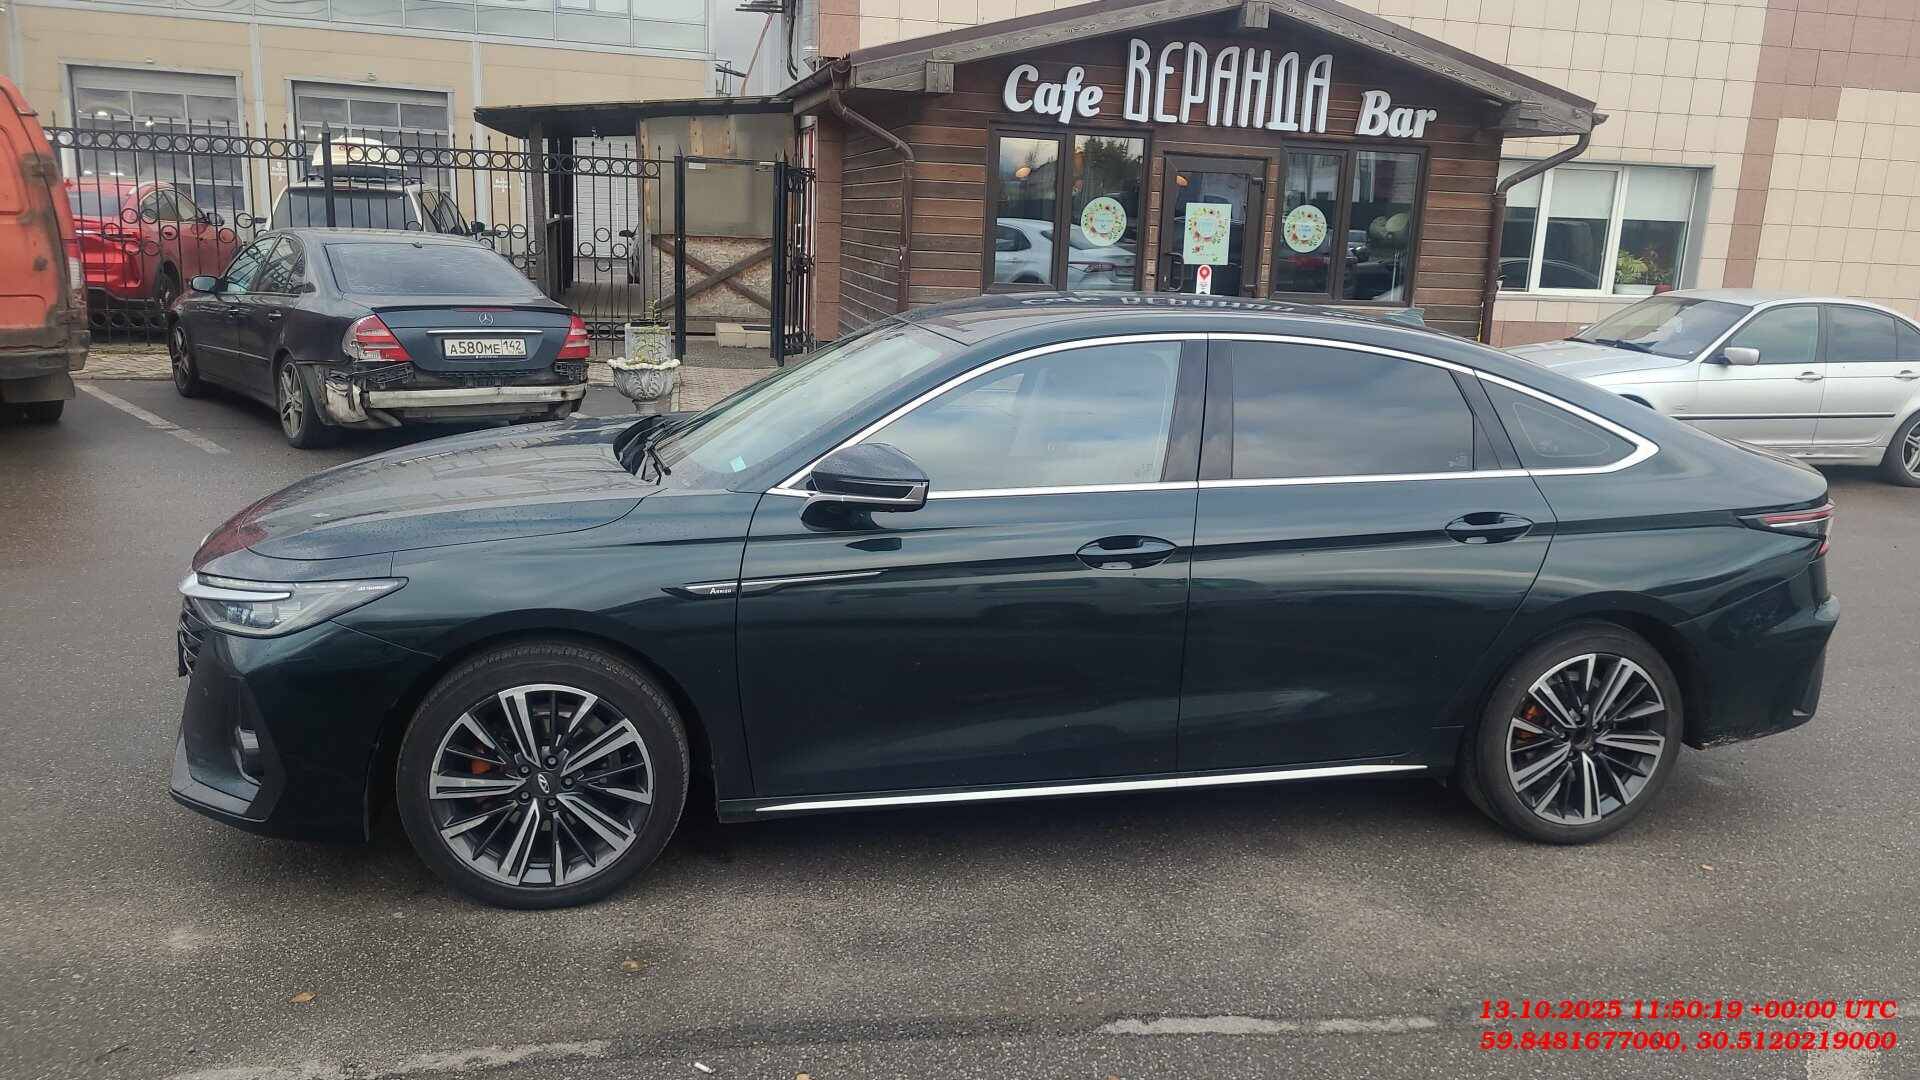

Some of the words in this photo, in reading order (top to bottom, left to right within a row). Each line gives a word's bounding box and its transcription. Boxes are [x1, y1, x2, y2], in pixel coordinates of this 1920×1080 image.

[1003, 63, 1104, 125] Cafe
[1122, 38, 1334, 134] ВЕРАНДА
[1355, 90, 1437, 139] Bar
